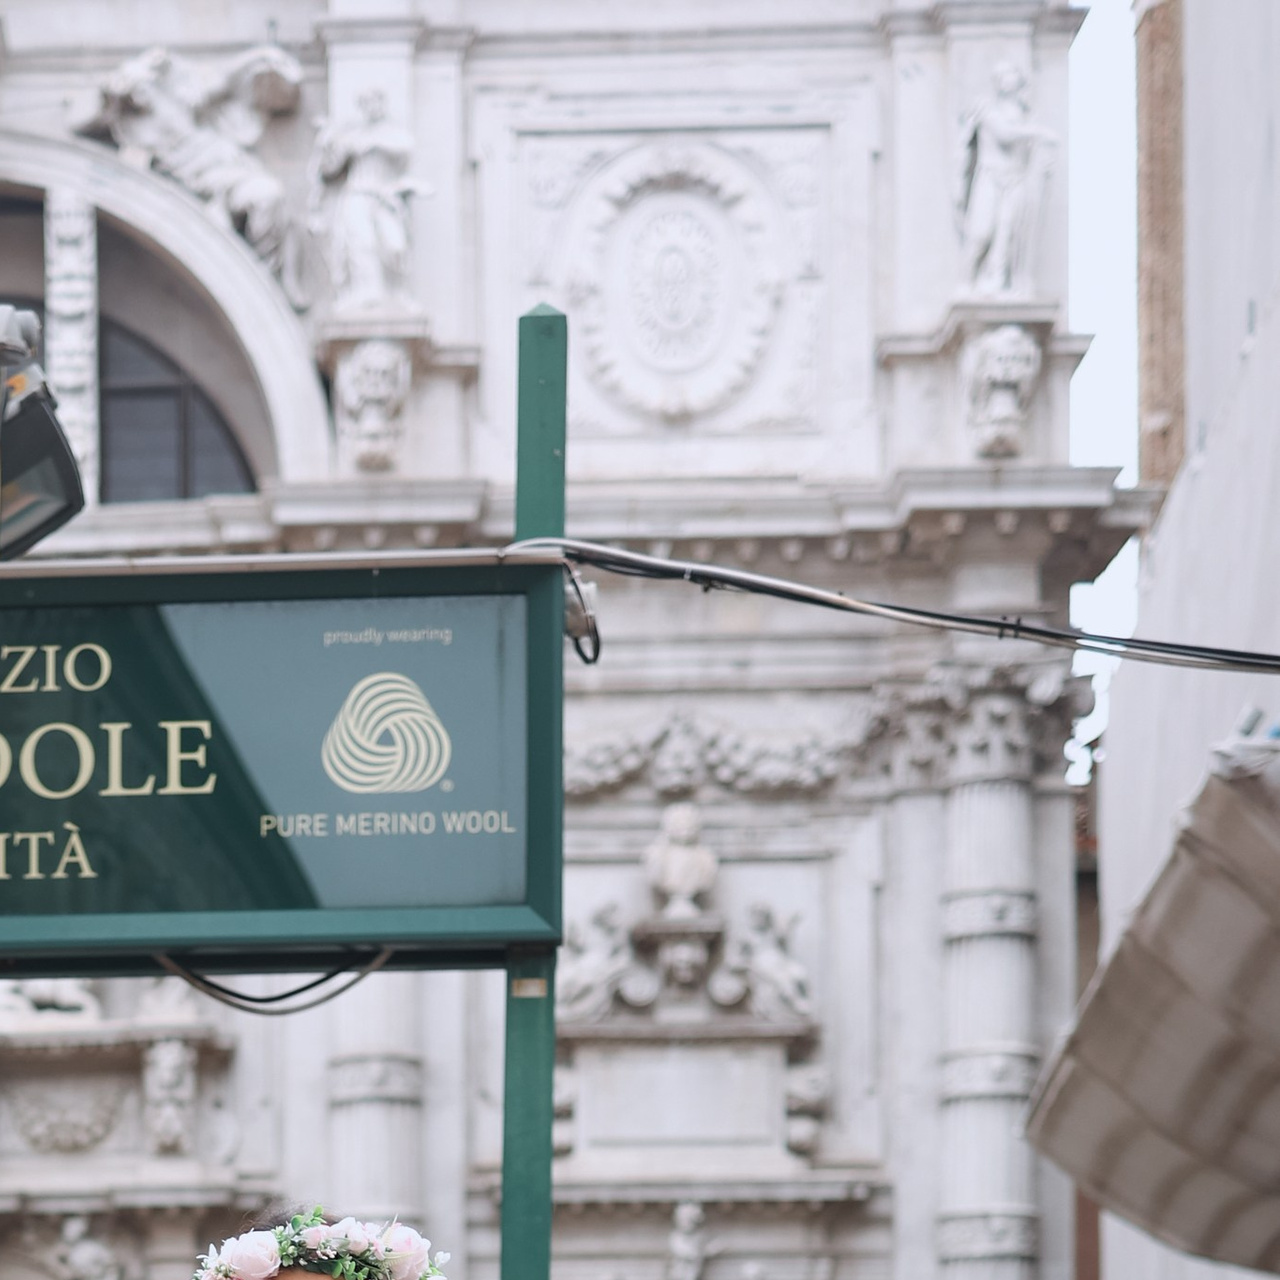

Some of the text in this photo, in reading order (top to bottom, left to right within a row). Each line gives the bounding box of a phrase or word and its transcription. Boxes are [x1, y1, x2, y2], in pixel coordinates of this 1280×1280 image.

[323, 627, 453, 647] proudly wearing
[260, 810, 516, 838] PURE MERINO WOOL
